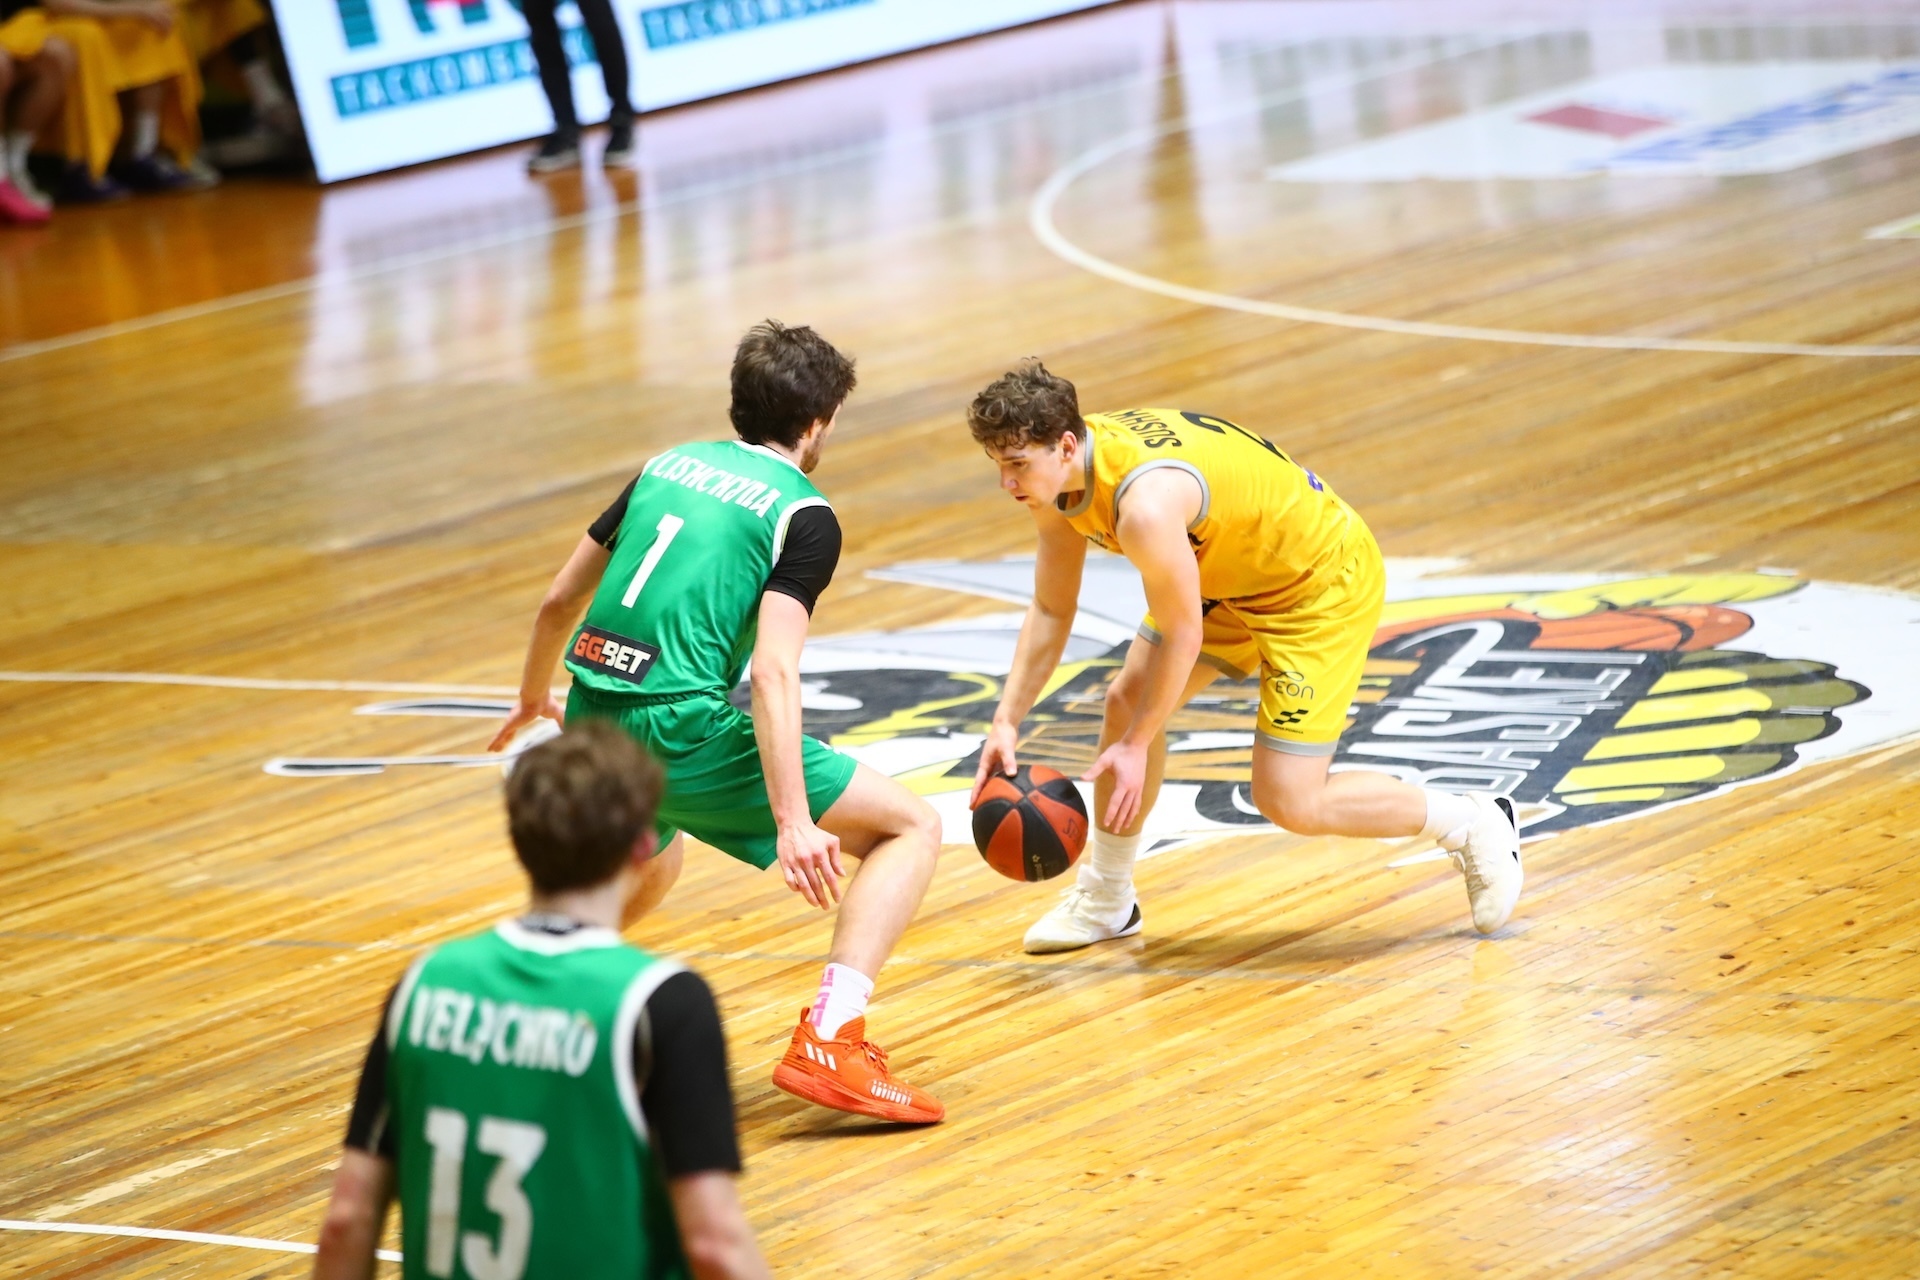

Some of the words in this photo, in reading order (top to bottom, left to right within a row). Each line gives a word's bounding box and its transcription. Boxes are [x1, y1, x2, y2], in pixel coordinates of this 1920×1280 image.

[650, 452, 782, 519] LISHCHYNA
[620, 512, 685, 609] 1
[424, 1106, 547, 1280] 13
